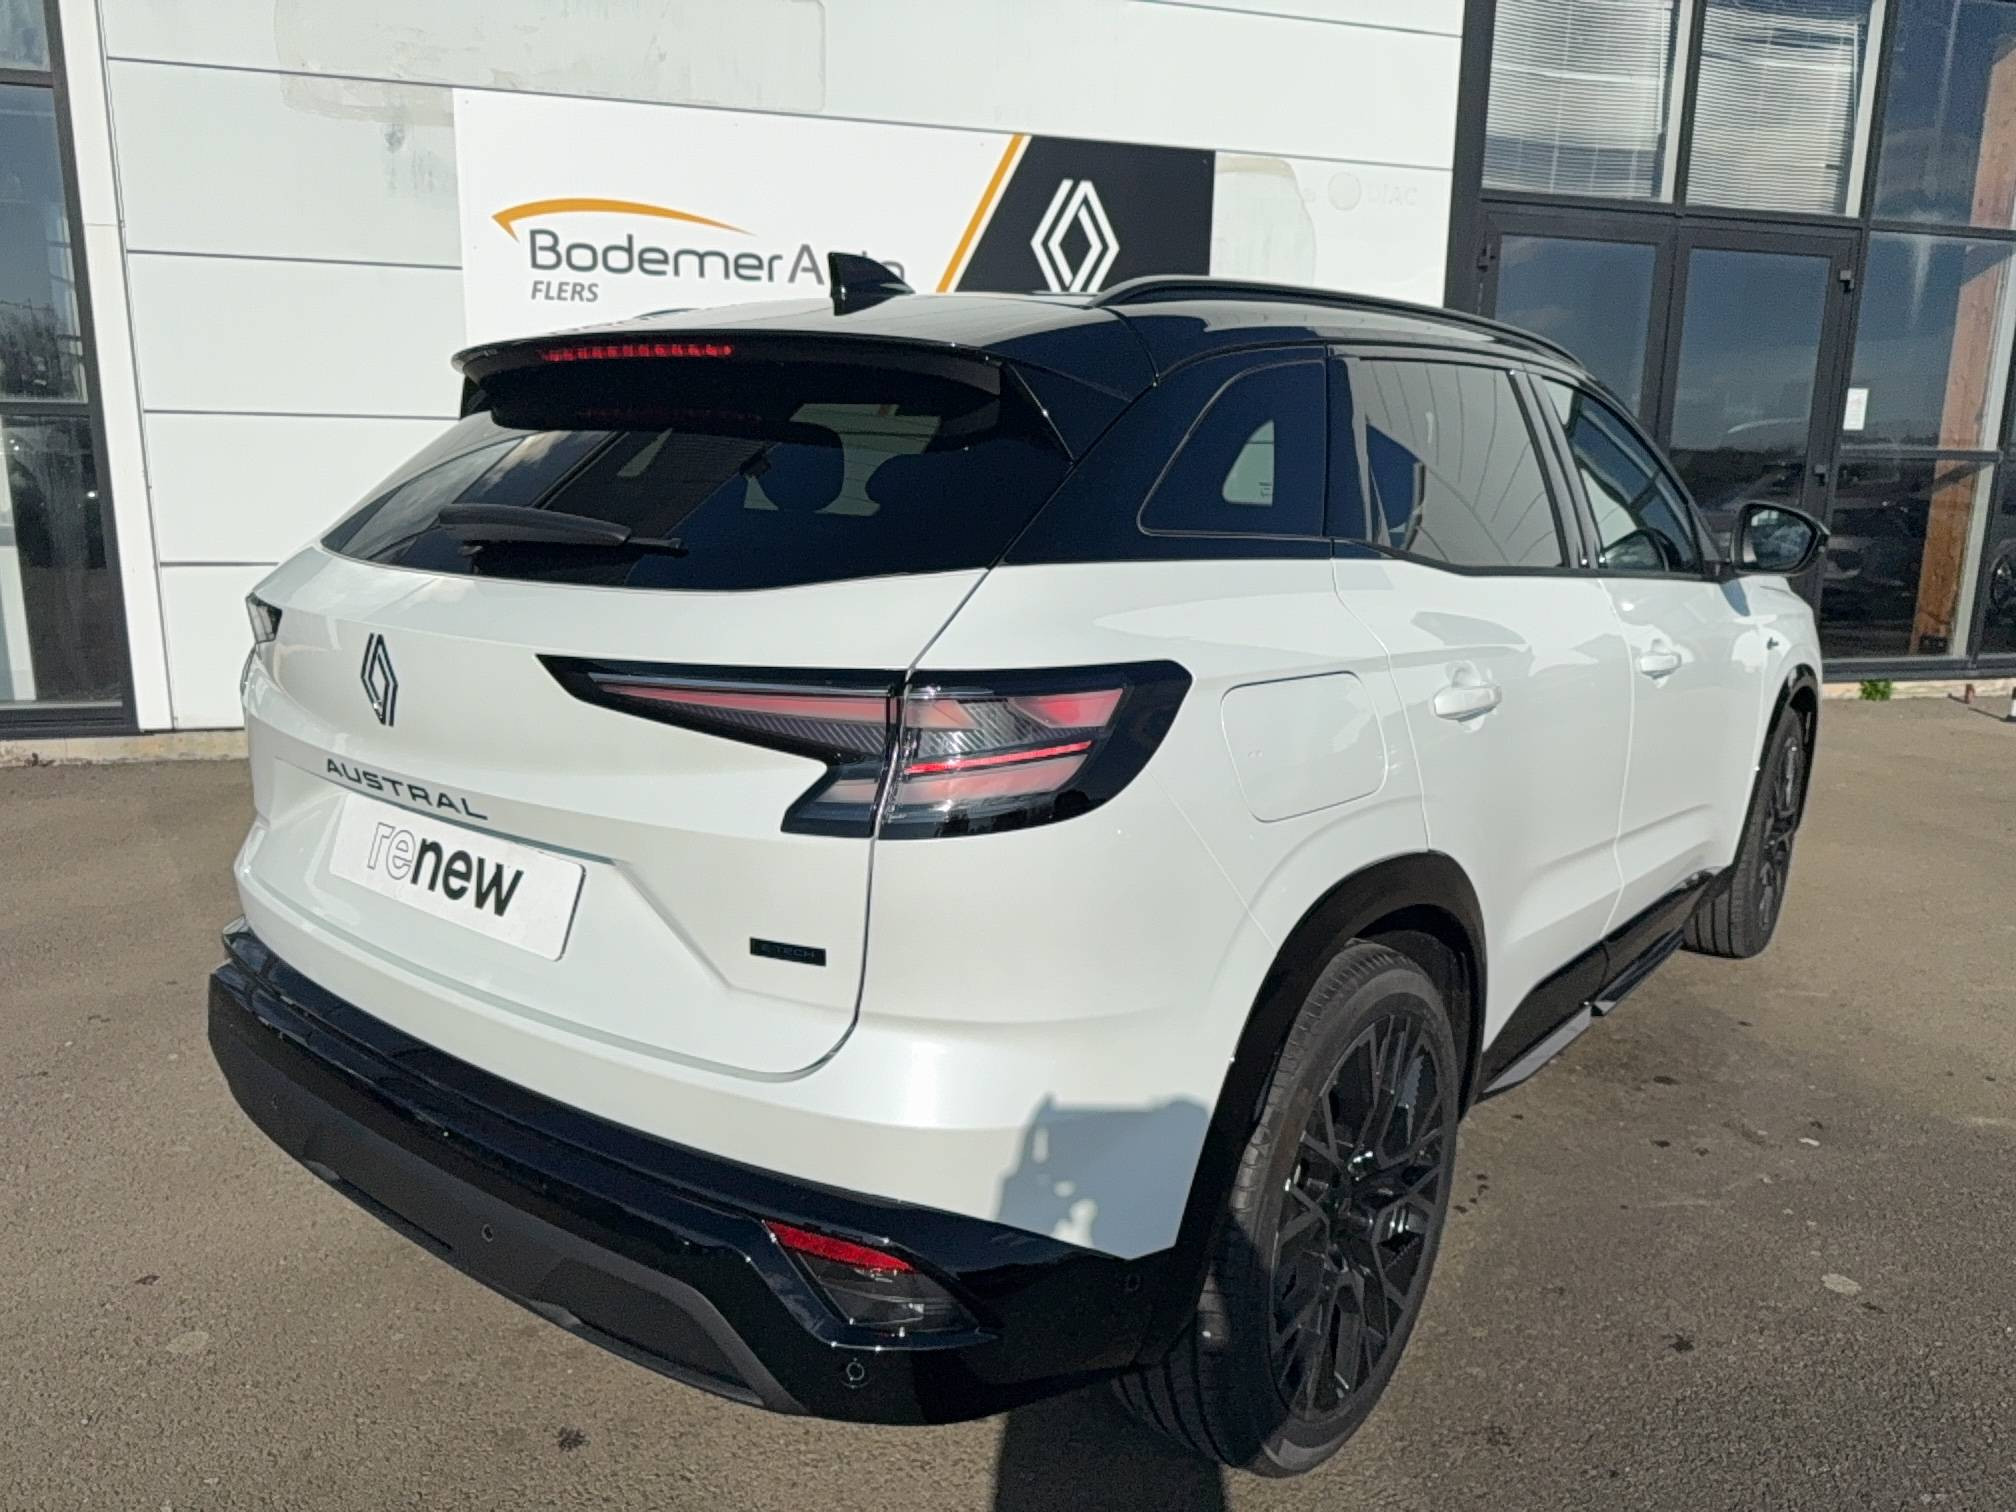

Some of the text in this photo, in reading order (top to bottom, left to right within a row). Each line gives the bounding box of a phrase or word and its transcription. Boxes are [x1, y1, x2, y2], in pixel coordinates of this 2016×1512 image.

[531, 280, 599, 302] FLERS
[327, 758, 488, 820] AUSTRAL
[367, 821, 524, 917] renew
